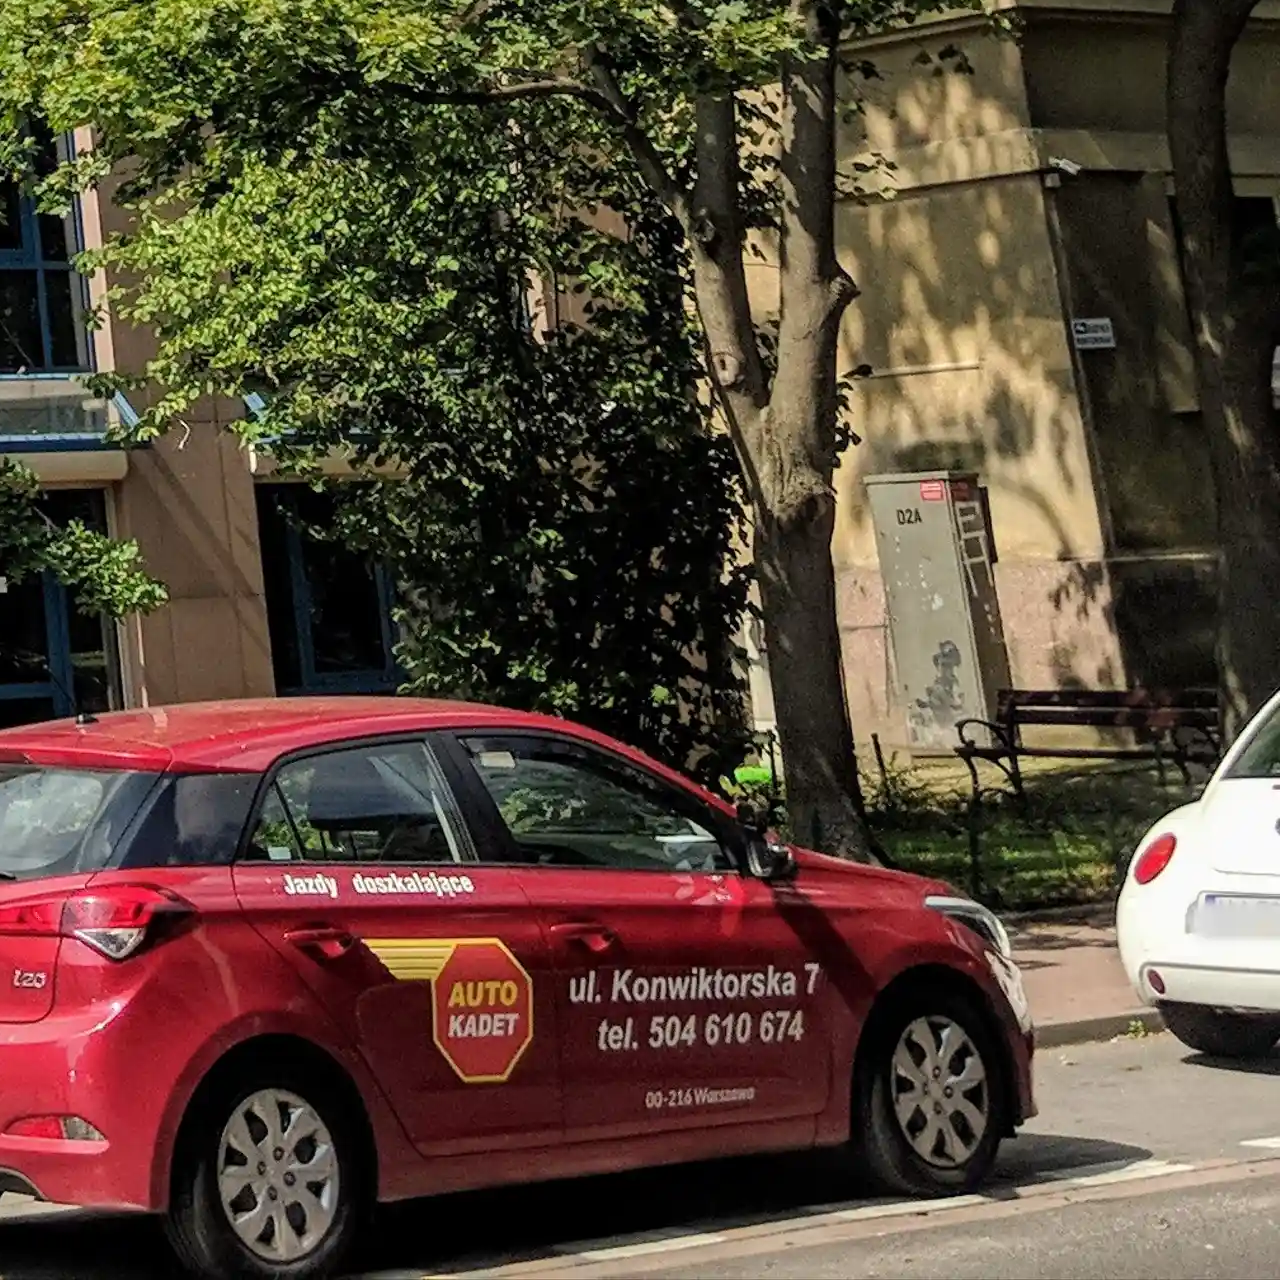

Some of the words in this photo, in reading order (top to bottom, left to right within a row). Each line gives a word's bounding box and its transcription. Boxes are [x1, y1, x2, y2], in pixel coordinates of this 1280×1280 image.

[284, 873, 338, 899] Jazdy
[351, 871, 475, 899] doszkalające
[447, 979, 518, 1008] AUTO
[569, 975, 602, 1004] ul.
[611, 965, 797, 1003] Konwiktorska
[805, 963, 820, 995] 7
[447, 1013, 519, 1039] KADET
[598, 1020, 639, 1052] tel.
[649, 1014, 697, 1048] 504
[705, 1012, 751, 1045] 610
[759, 1010, 805, 1043] 674
[645, 1088, 693, 1109] 00-216
